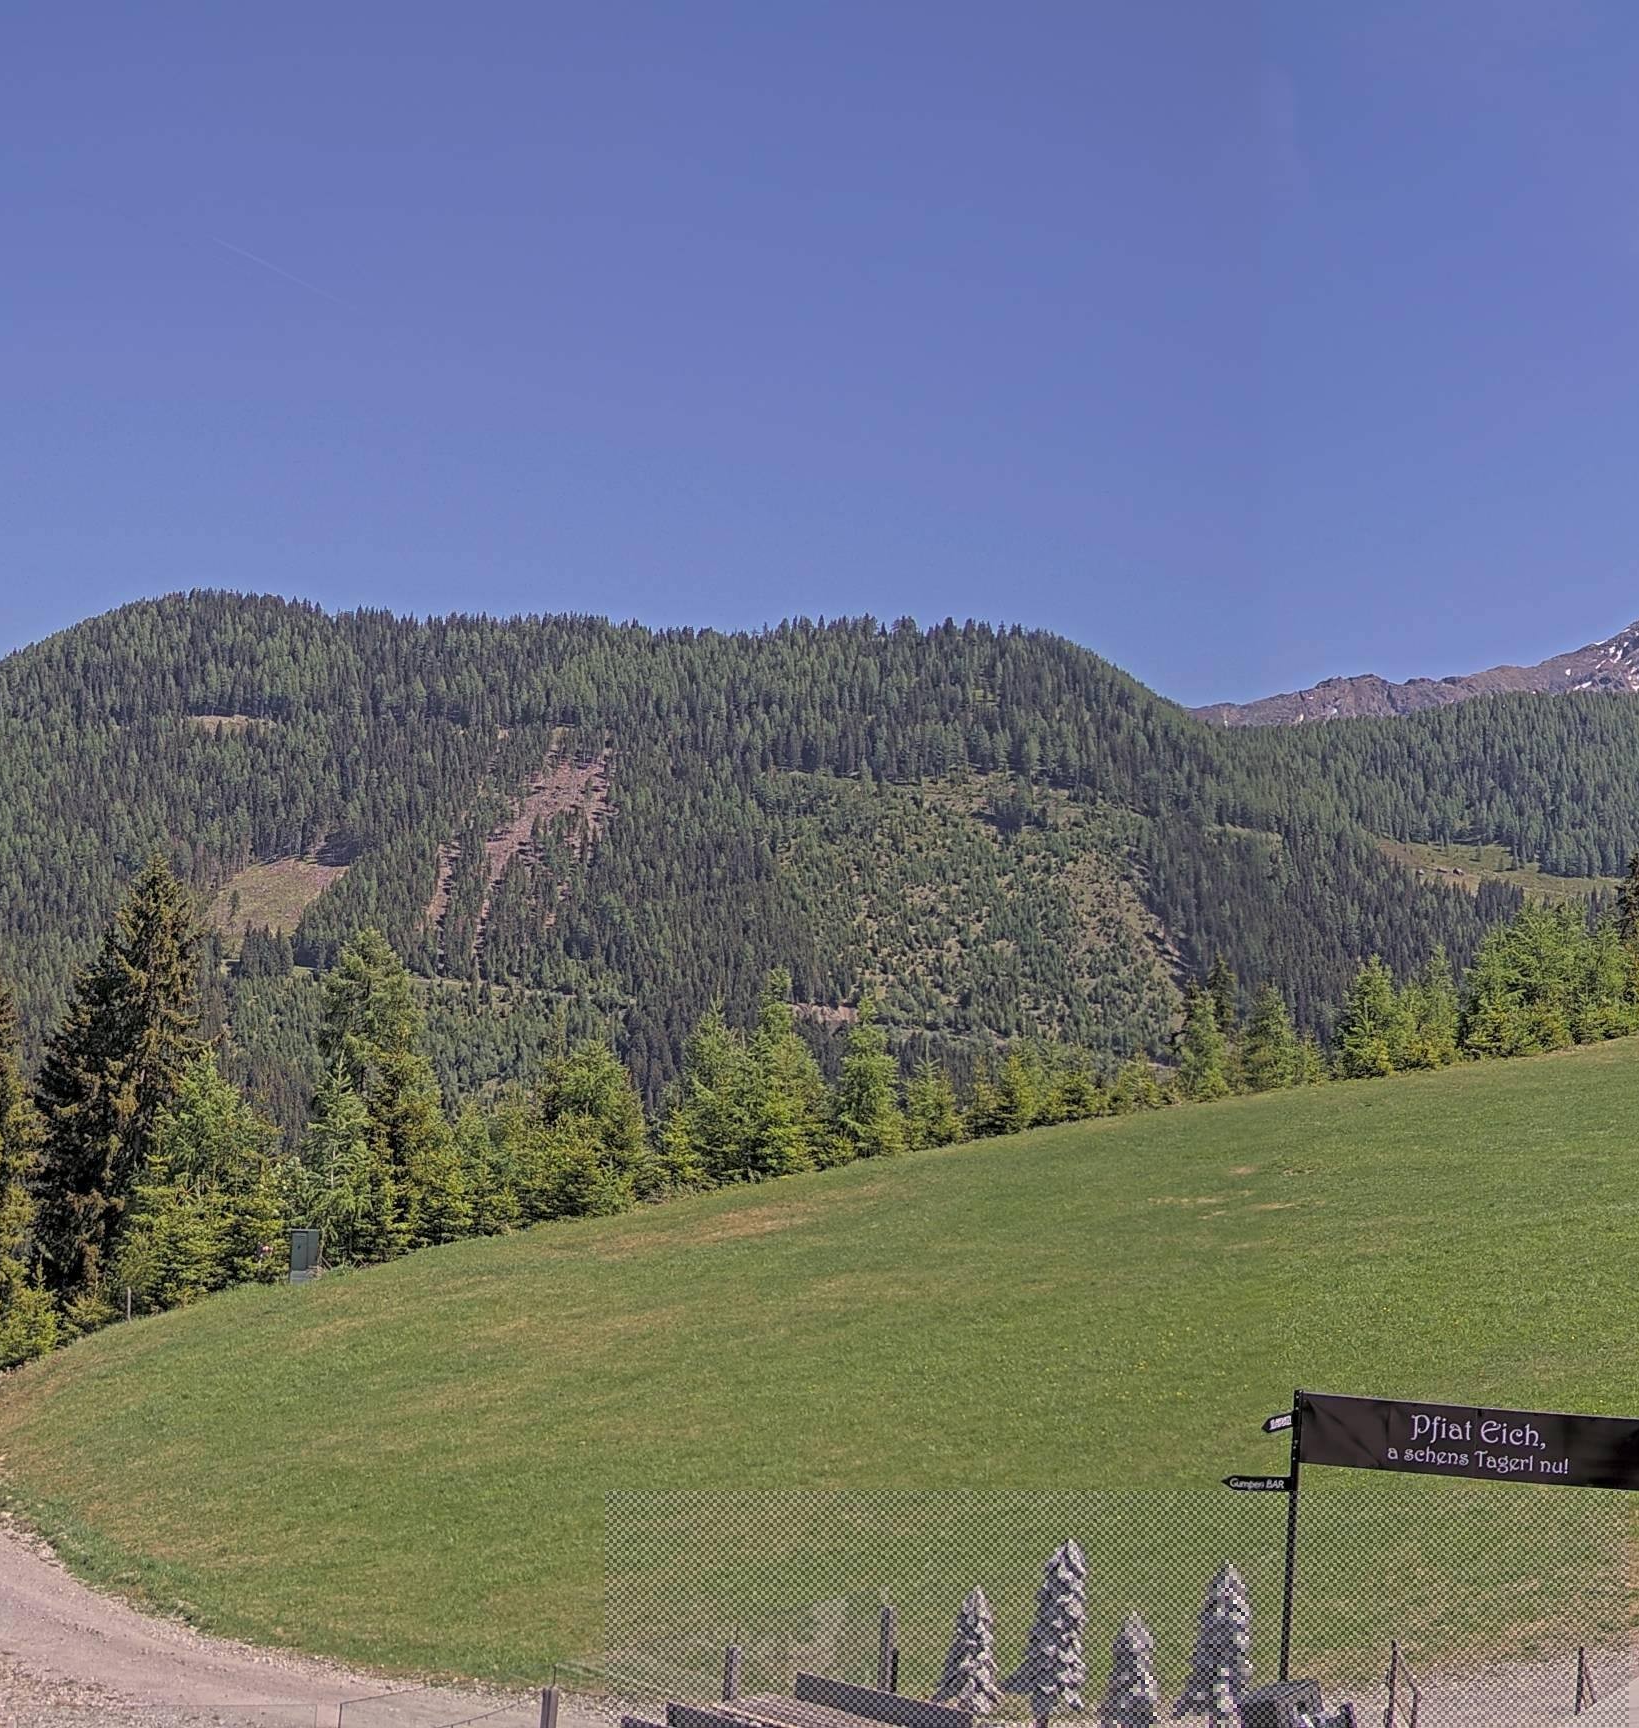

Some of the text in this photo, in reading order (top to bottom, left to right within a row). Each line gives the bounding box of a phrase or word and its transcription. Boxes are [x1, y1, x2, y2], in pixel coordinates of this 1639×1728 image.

[1411, 1415, 1546, 1450] Pfiat Eich,
[1388, 1447, 1570, 1474] a schens Tagerl nu!
[1265, 1479, 1285, 1489] BAR
